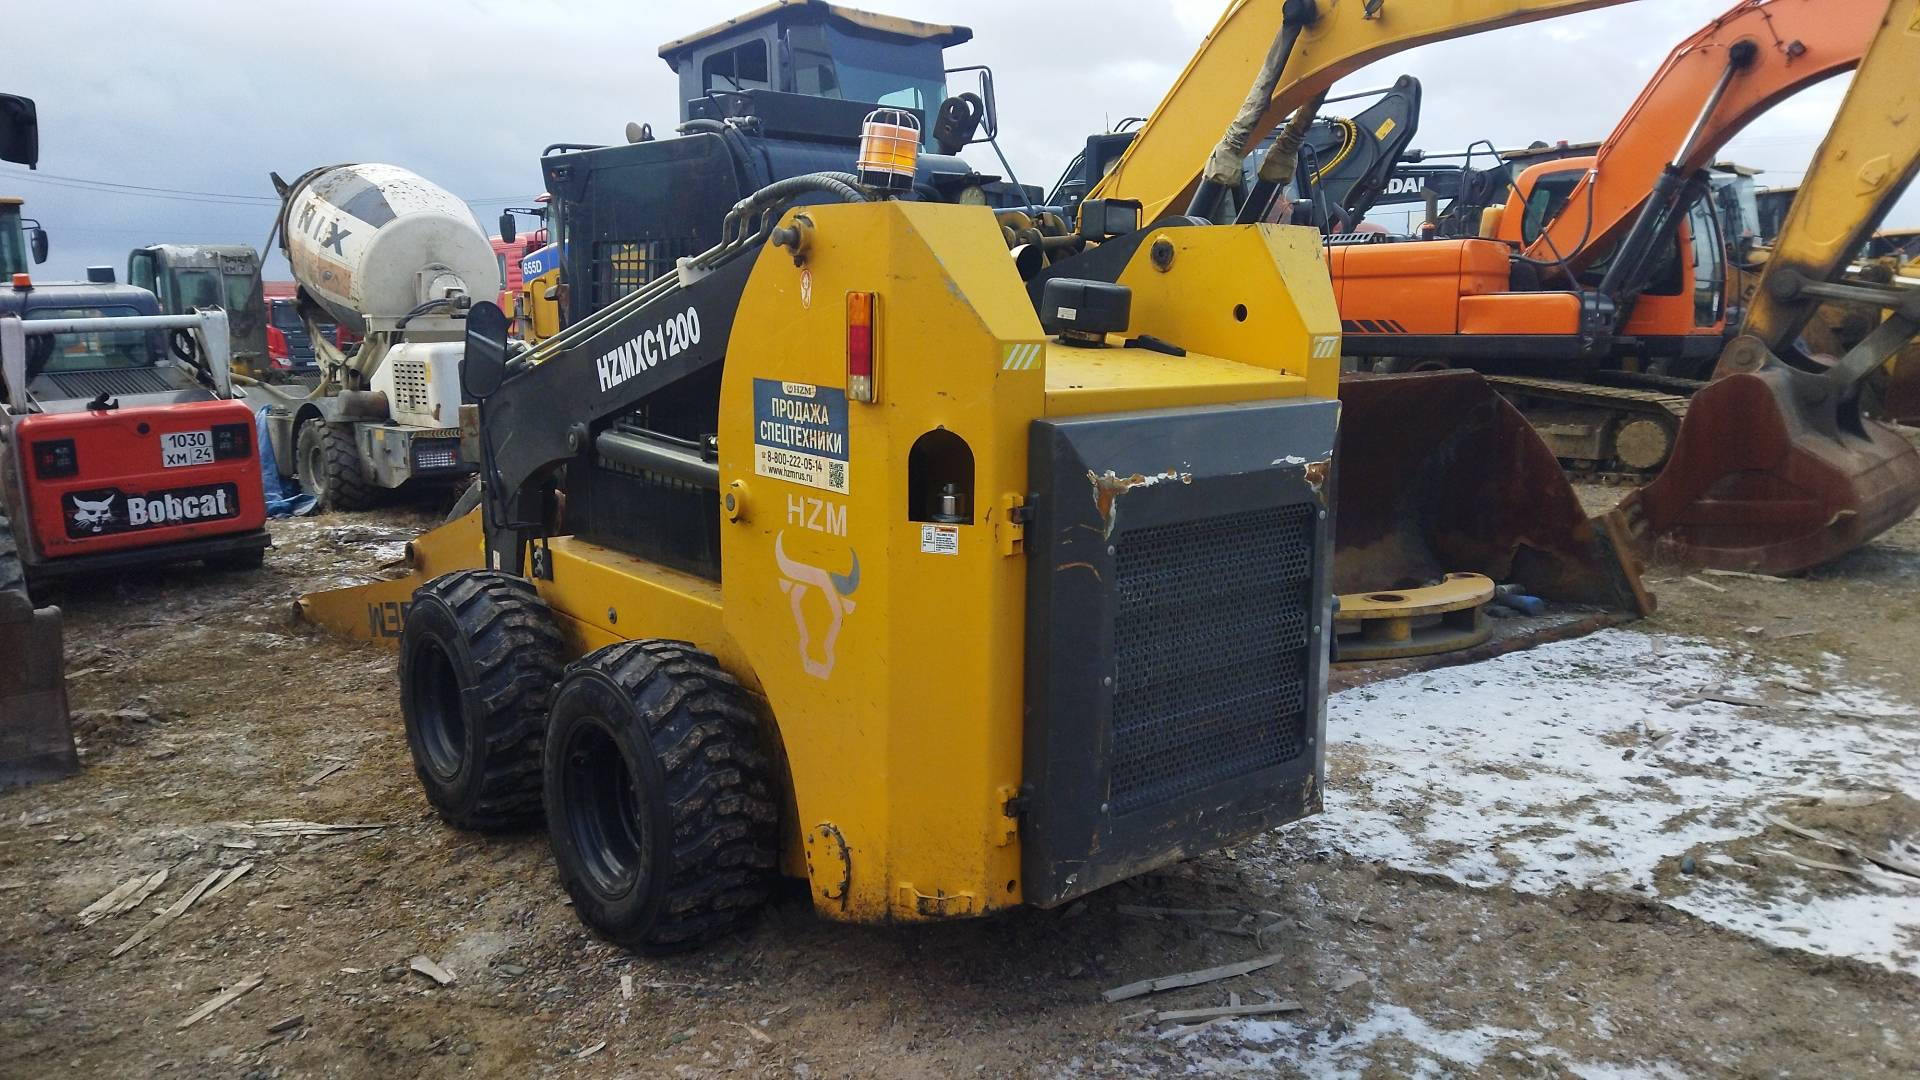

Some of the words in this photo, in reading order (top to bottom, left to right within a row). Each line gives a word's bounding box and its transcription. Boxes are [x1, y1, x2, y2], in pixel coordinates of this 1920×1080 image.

[524, 260, 541, 274] 655D
[596, 306, 701, 393] HZMXC1200
[793, 385, 812, 395] HZM
[771, 397, 829, 425] ПРОДАЖА
[168, 432, 207, 448] 1030
[760, 420, 842, 454] СПЕЦТЕХНИКИ
[195, 447, 211, 459] 24
[767, 450, 823, 473] 8-800-222-05-14
[767, 465, 813, 483] www.hzmrus.ru
[127, 489, 228, 525] Bobcat
[787, 493, 848, 537] HZM
